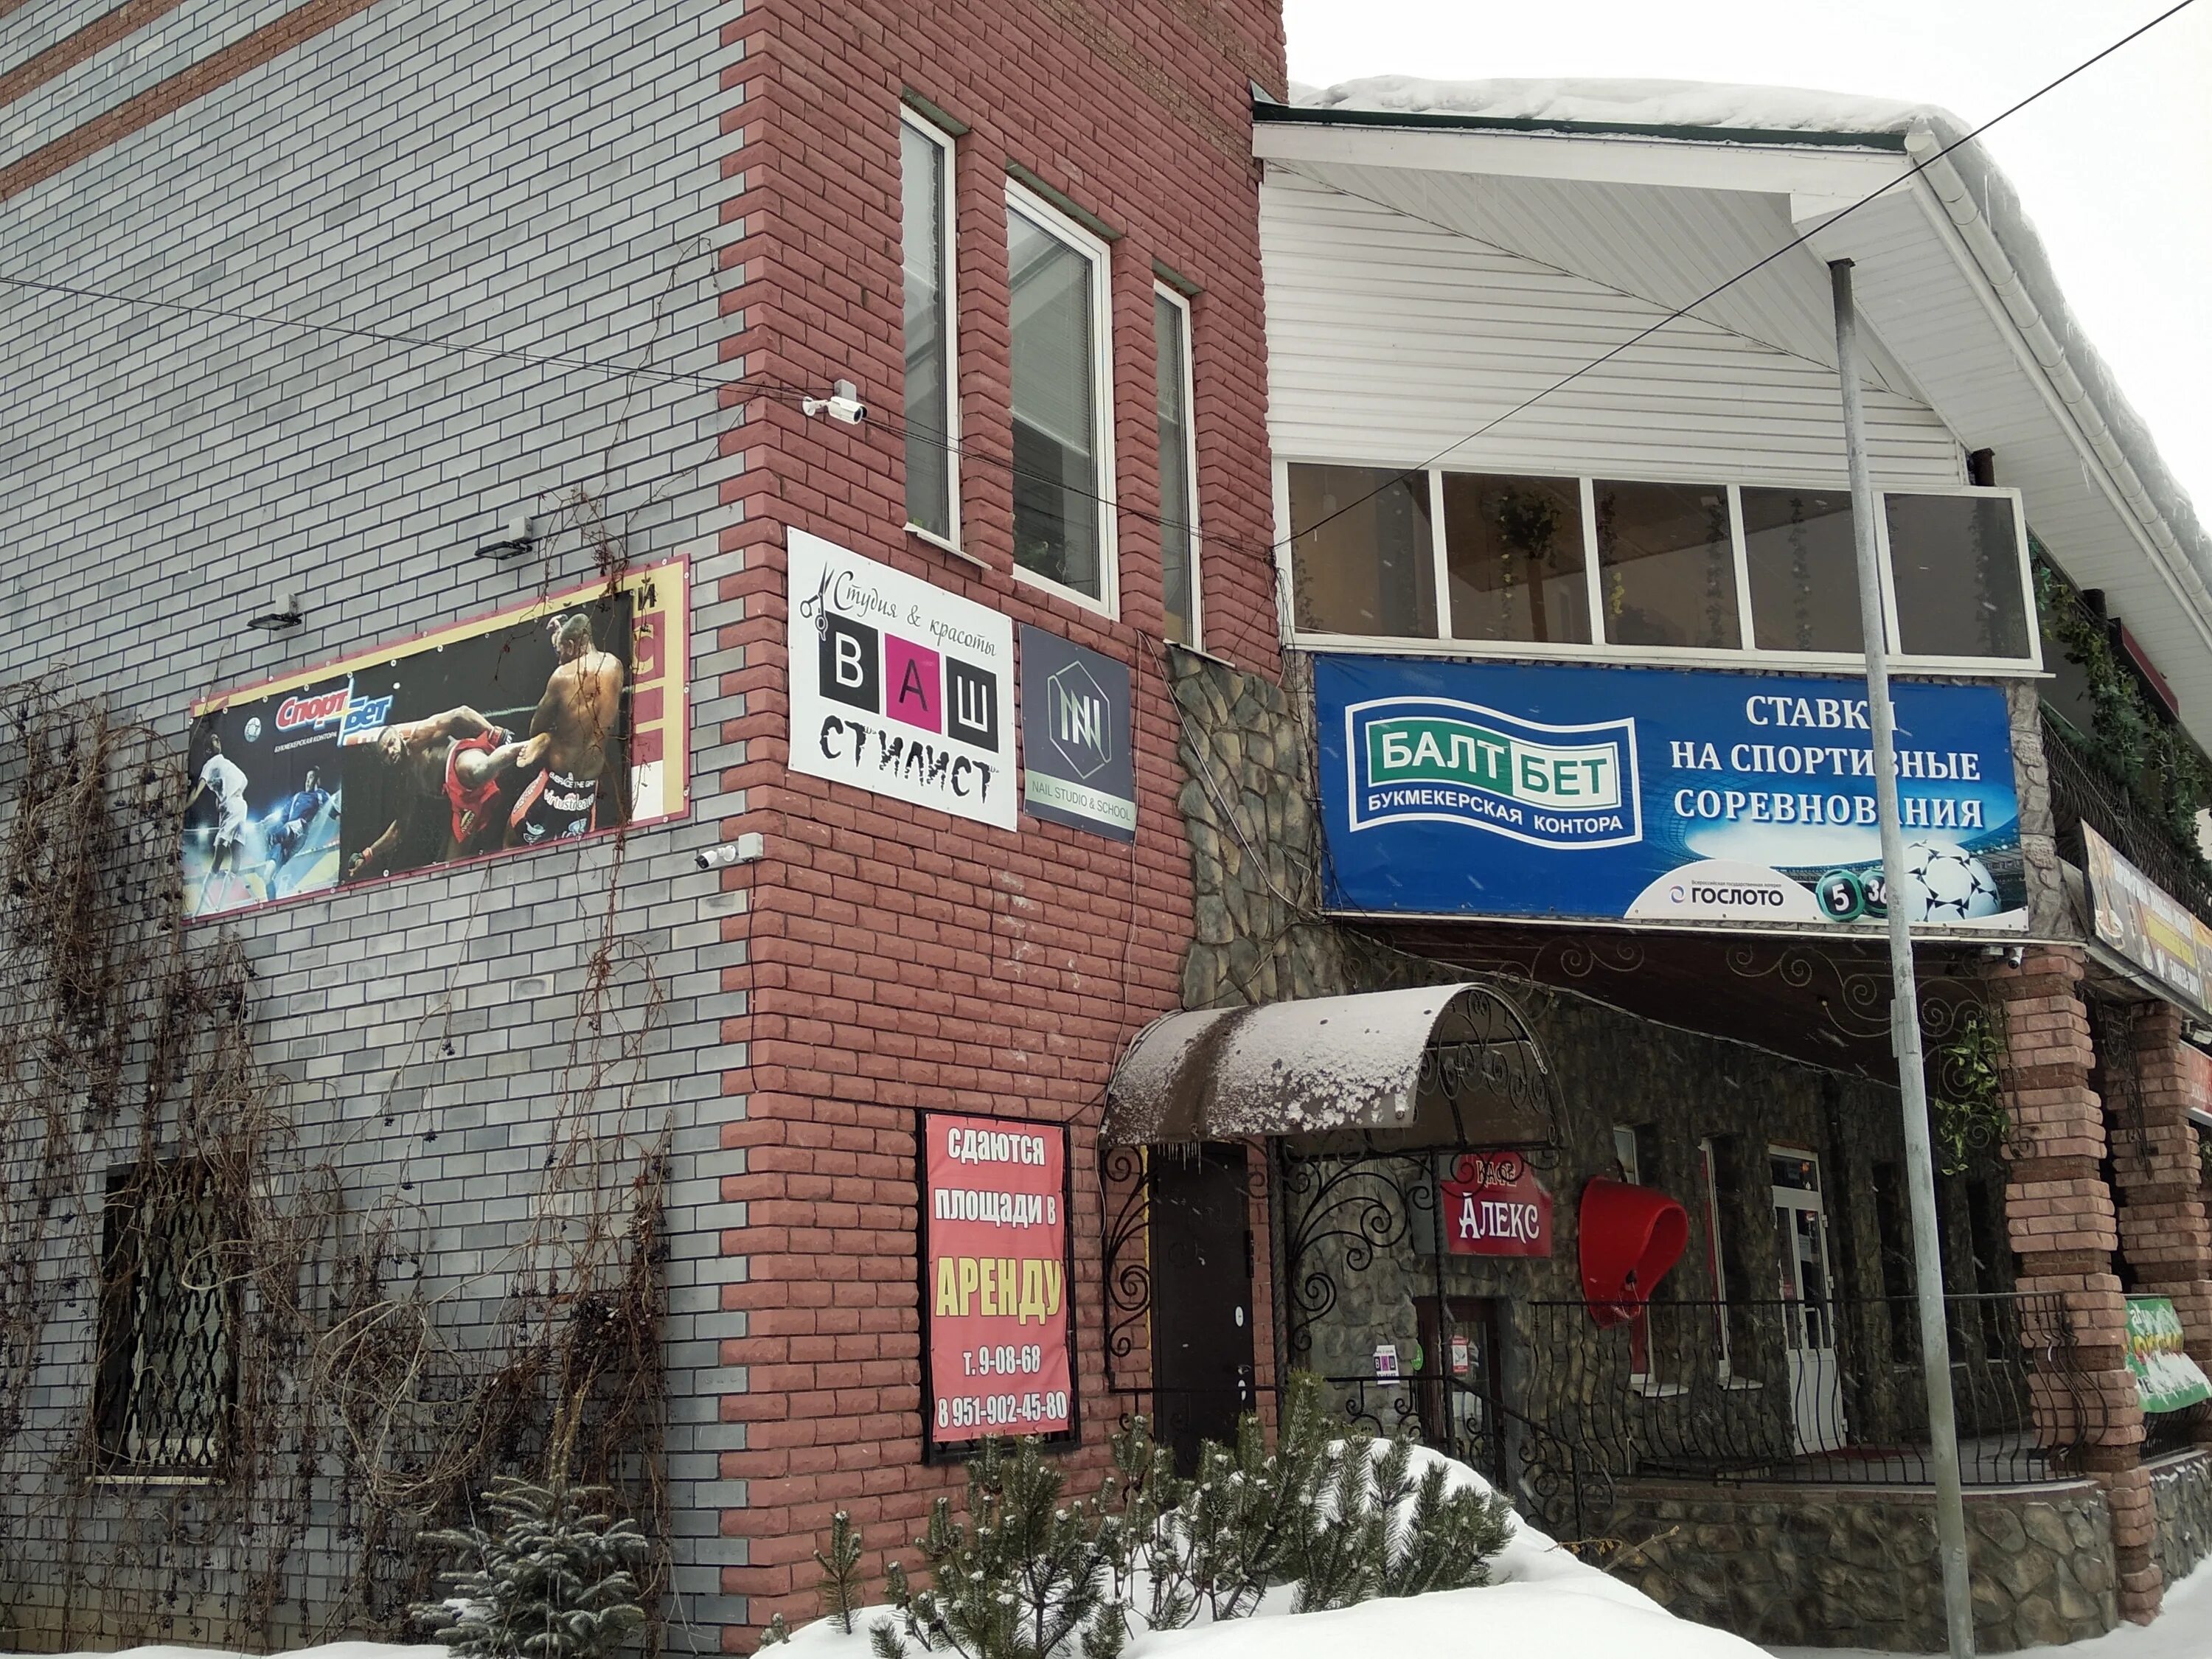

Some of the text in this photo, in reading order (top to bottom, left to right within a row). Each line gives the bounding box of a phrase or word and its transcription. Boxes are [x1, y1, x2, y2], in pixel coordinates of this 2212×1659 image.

[833, 571, 997, 656] Студия & красоты
[835, 630, 989, 733] ВАШ
[313, 731, 337, 742] КОНТОРА
[1669, 740, 1723, 771] НА
[819, 714, 995, 804] СТИЛИСТ
[1032, 780, 1131, 821] NAIL STUDIO & SCHOOL
[1368, 789, 1624, 834] БУКМЕКЕРСКАЯ КОНТОРА
[1674, 789, 1983, 828] СОРЕВНОВНИЯ
[1691, 887, 1784, 906] ГОСЛОТО
[1832, 883, 1850, 911] 5
[935, 1256, 1062, 1325] АРЕНДУ
[937, 1391, 1068, 1428] 8 951-902-45-80
